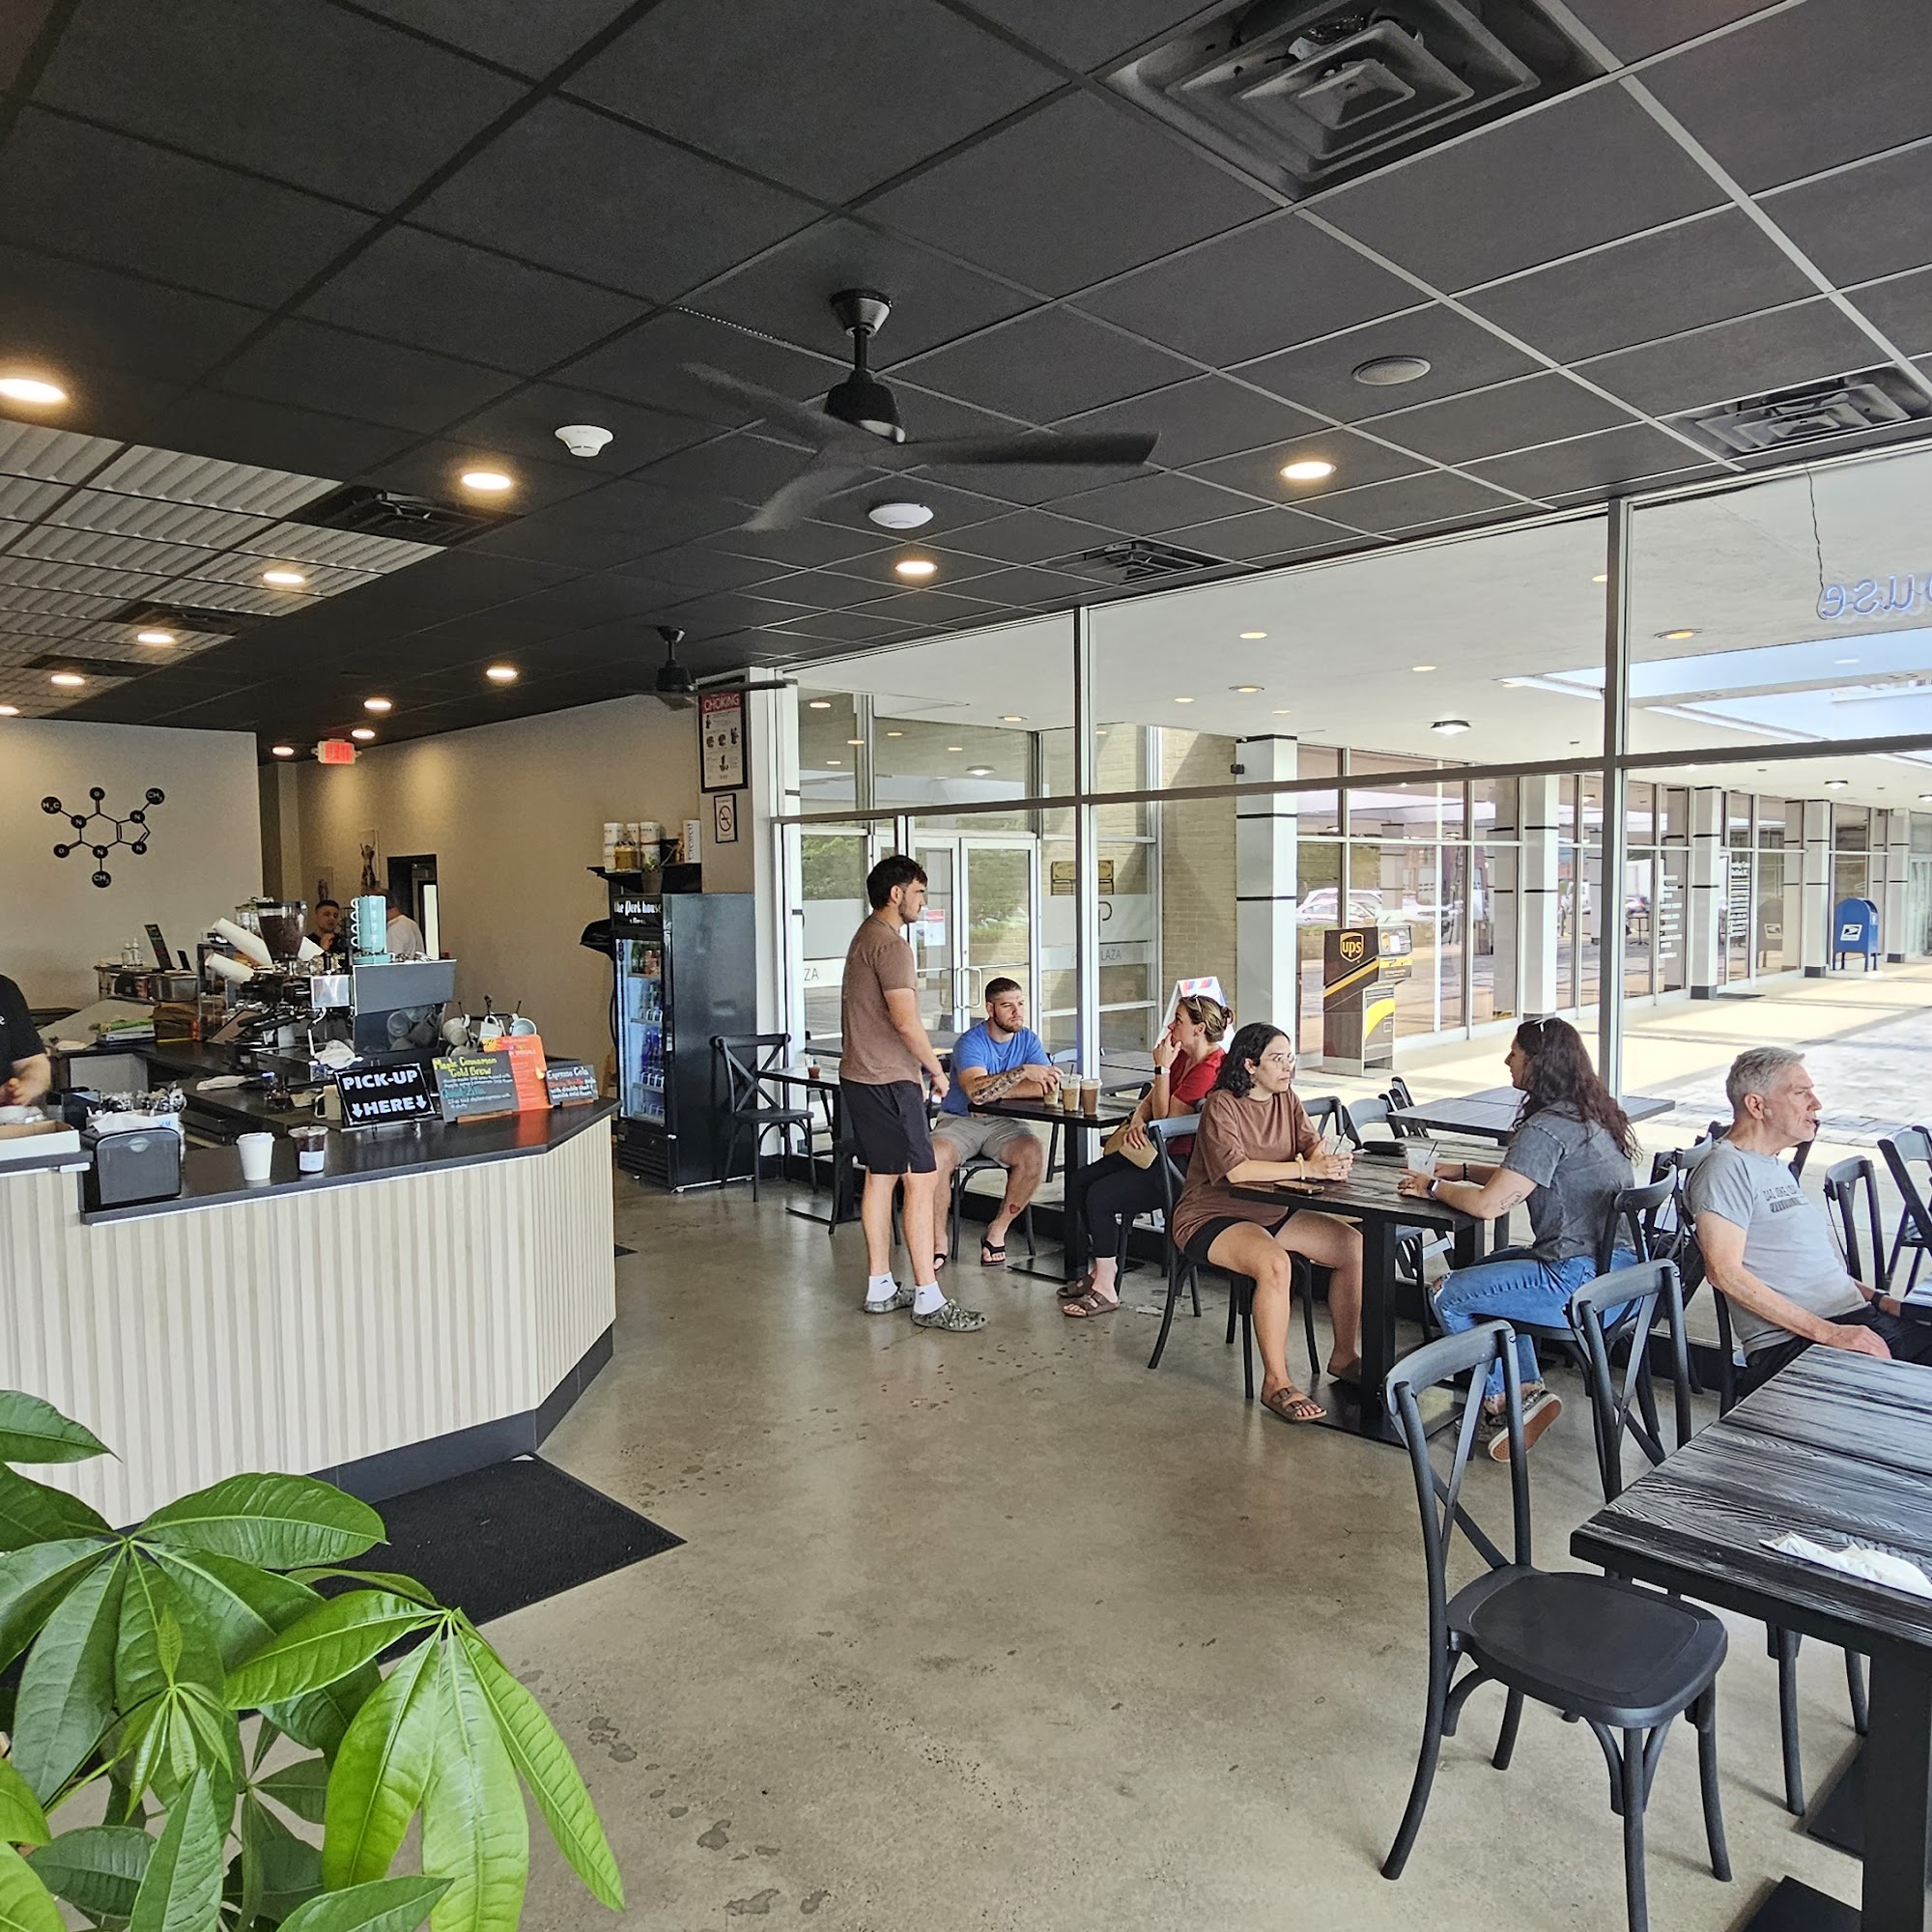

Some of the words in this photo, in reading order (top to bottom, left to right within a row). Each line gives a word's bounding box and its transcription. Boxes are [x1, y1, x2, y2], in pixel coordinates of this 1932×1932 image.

[704, 694, 741, 711] CHOKING
[1099, 950, 1122, 961] LAZA
[1342, 941, 1362, 957] ups
[804, 968, 820, 981] ZA
[342, 1069, 418, 1091] PICK-UP
[362, 1096, 416, 1116] HERE
